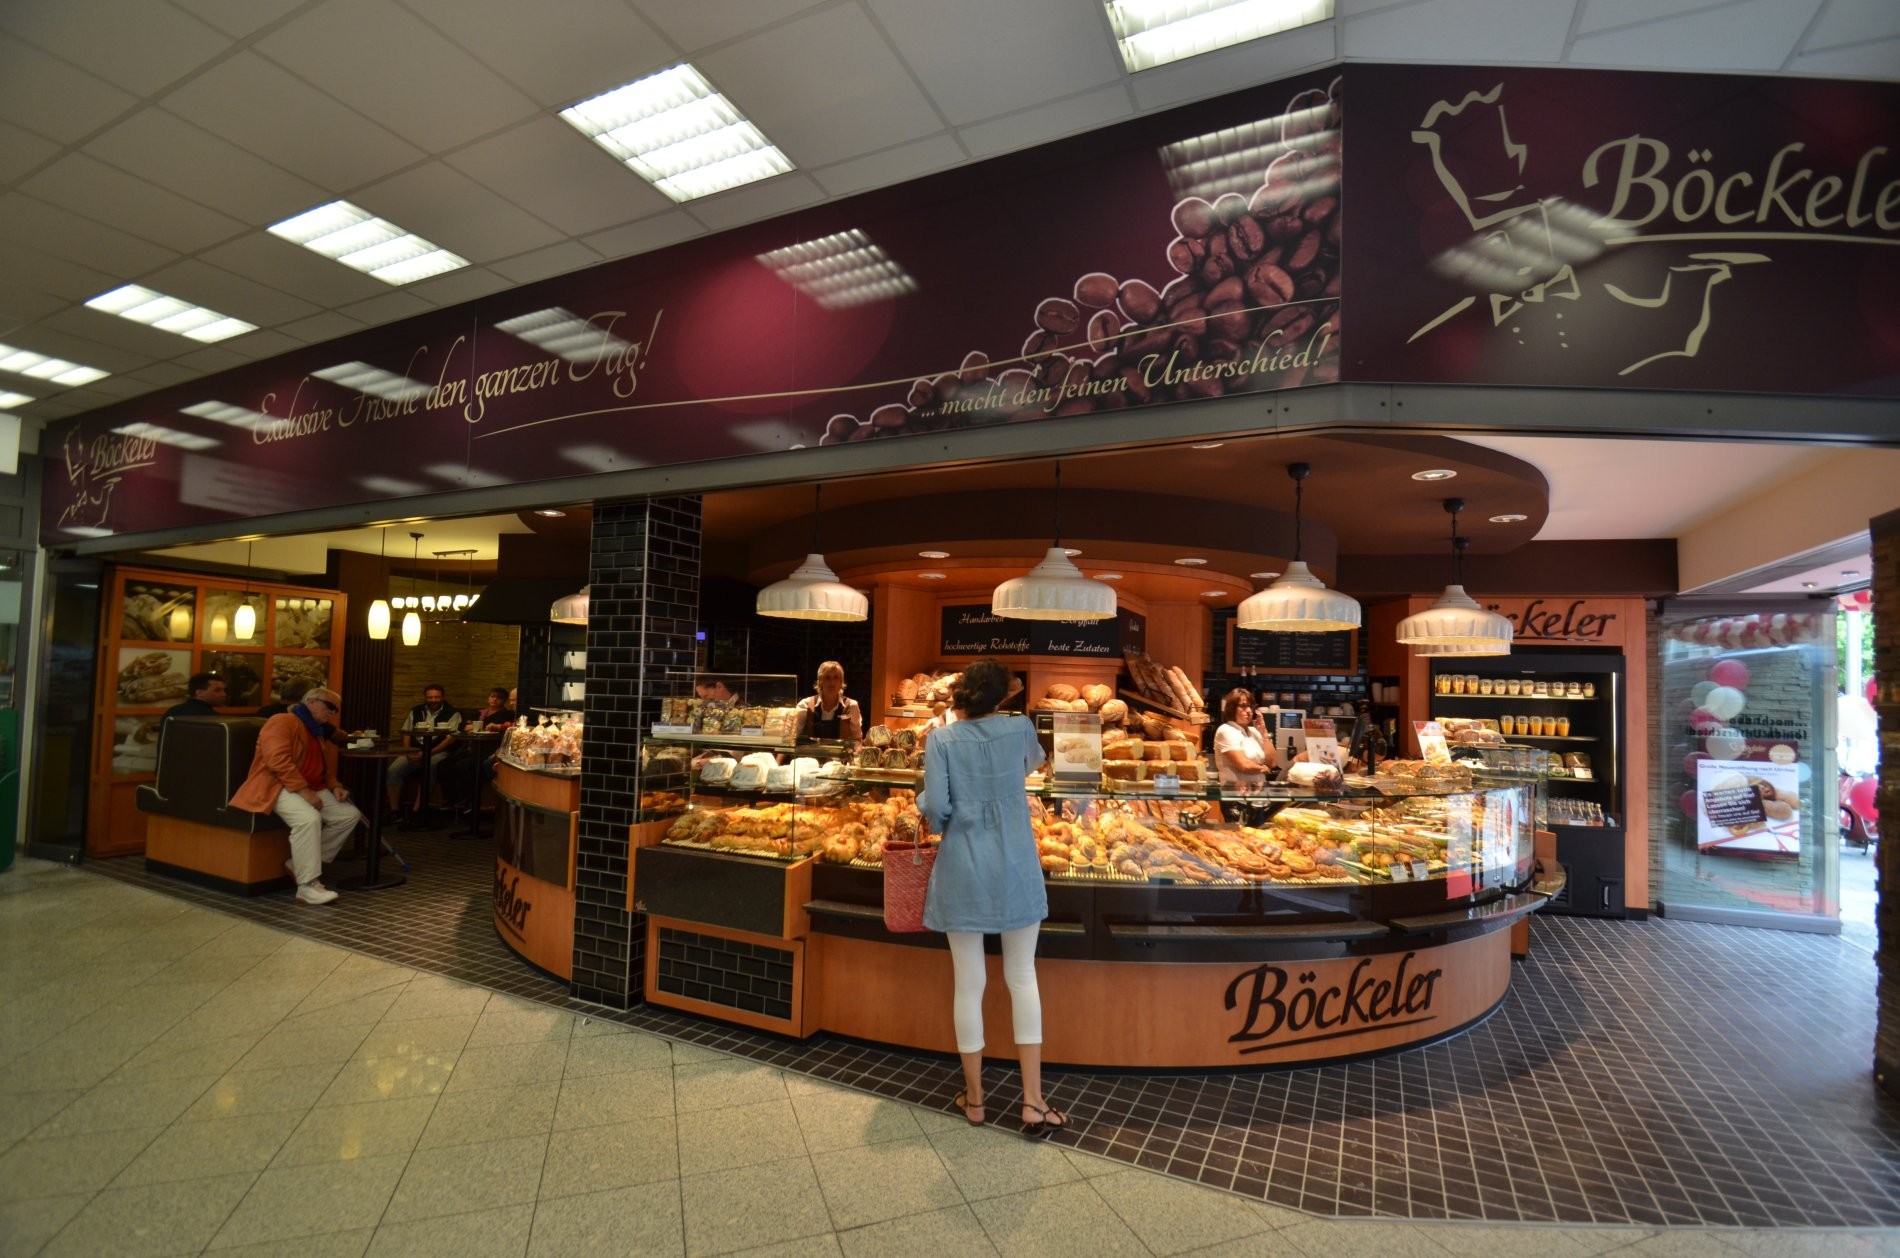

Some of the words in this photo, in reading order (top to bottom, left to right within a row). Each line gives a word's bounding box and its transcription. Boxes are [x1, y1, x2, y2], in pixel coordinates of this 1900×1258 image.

[253, 375, 332, 444] Exclusive
[425, 335, 466, 411] den
[464, 357, 559, 423] ganzen
[569, 309, 664, 398] Tag!
[1012, 364, 1050, 406] den
[1044, 358, 1129, 413] feinen
[1138, 322, 1331, 388] Unterschied!
[90, 427, 156, 475] Böckeler
[990, 638, 1030, 652] Rohstoffe
[1048, 640, 1070, 651] beste
[1074, 640, 1110, 653] Zutaten
[1224, 952, 1442, 1043] Böckeler
